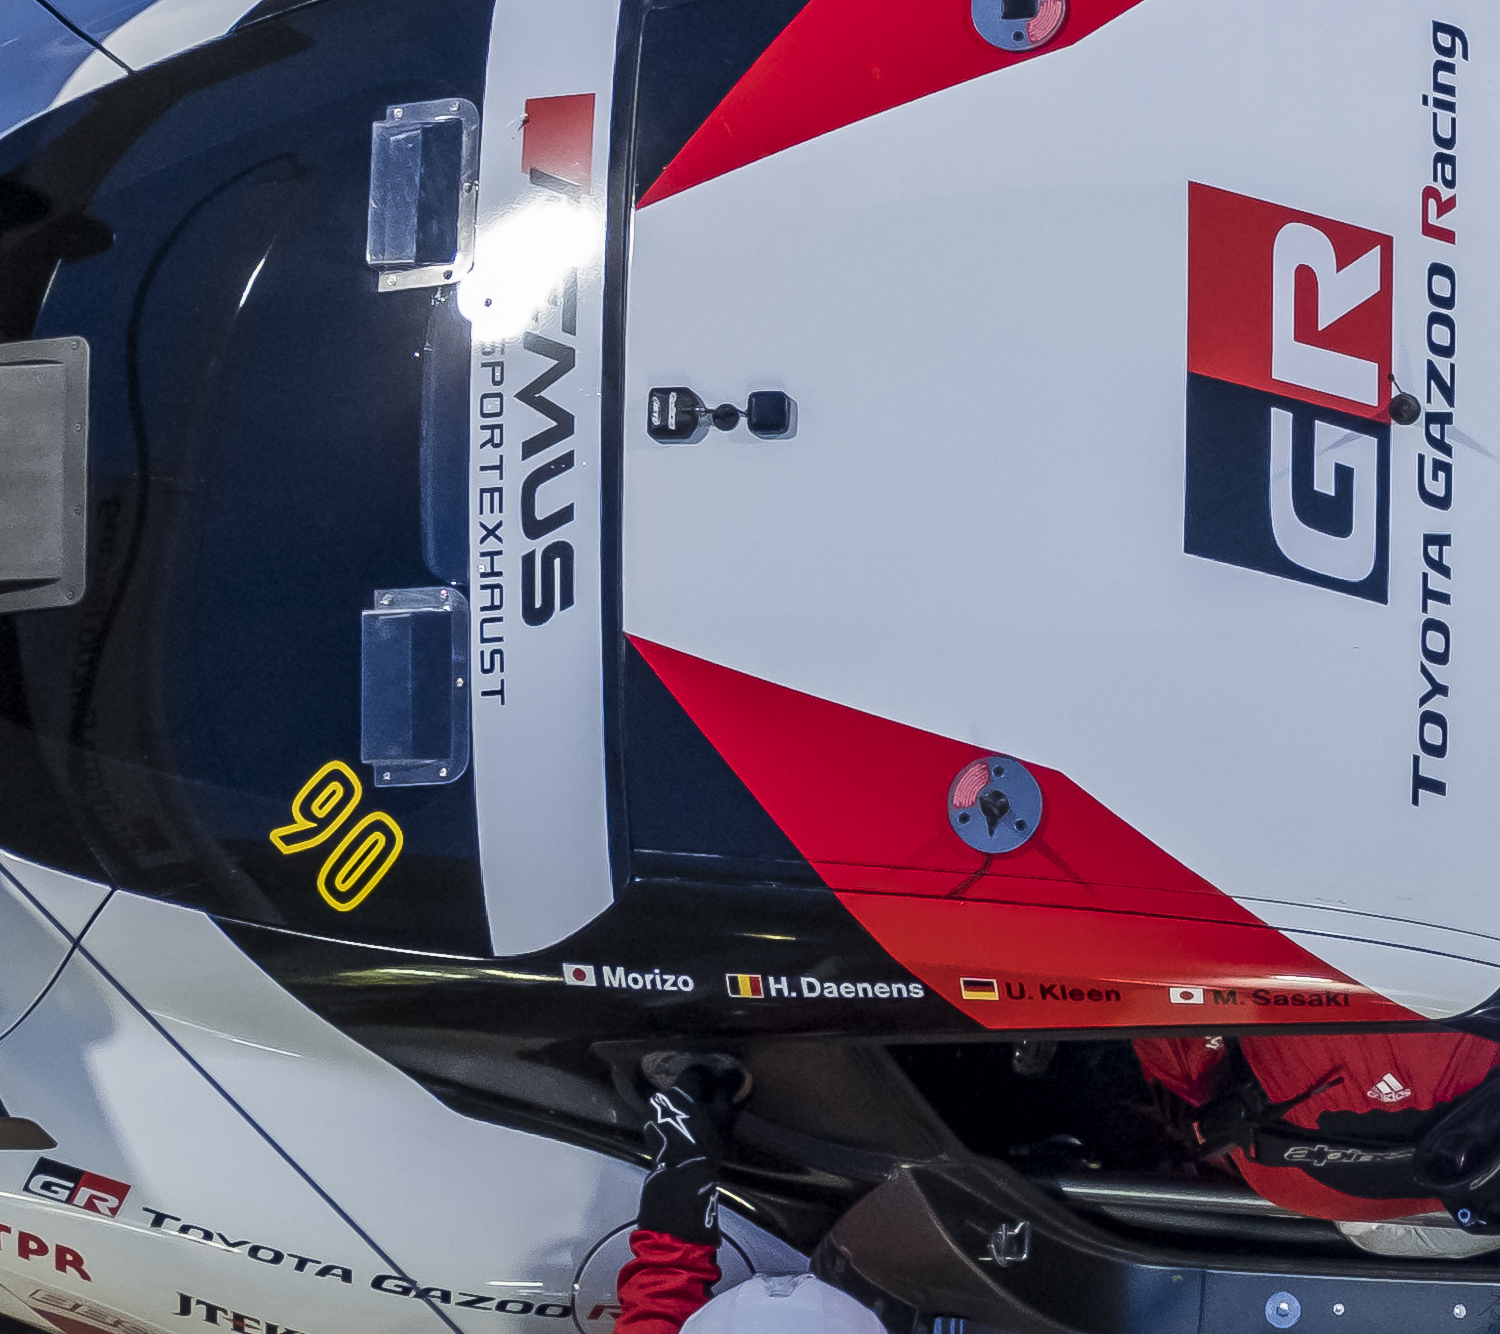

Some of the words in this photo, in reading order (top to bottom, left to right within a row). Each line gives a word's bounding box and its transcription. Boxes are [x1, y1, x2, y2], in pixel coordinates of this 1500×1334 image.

[1420, 19, 1469, 245] Racing
[1268, 221, 1382, 584] GR
[1415, 262, 1459, 512] GAZOO
[1410, 533, 1453, 807] TOYOTA
[269, 759, 404, 912] 90
[603, 967, 695, 993] Morizo
[801, 977, 926, 1000] Daenens
[1005, 982, 1034, 1002] U.
[1040, 984, 1122, 1003] Kleen
[1213, 989, 1246, 1007] M.
[1253, 988, 1351, 1008] Sasaki
[27, 1172, 121, 1217] GR
[141, 1207, 355, 1284] TOYOTA
[370, 1272, 574, 1319] GAZOO
